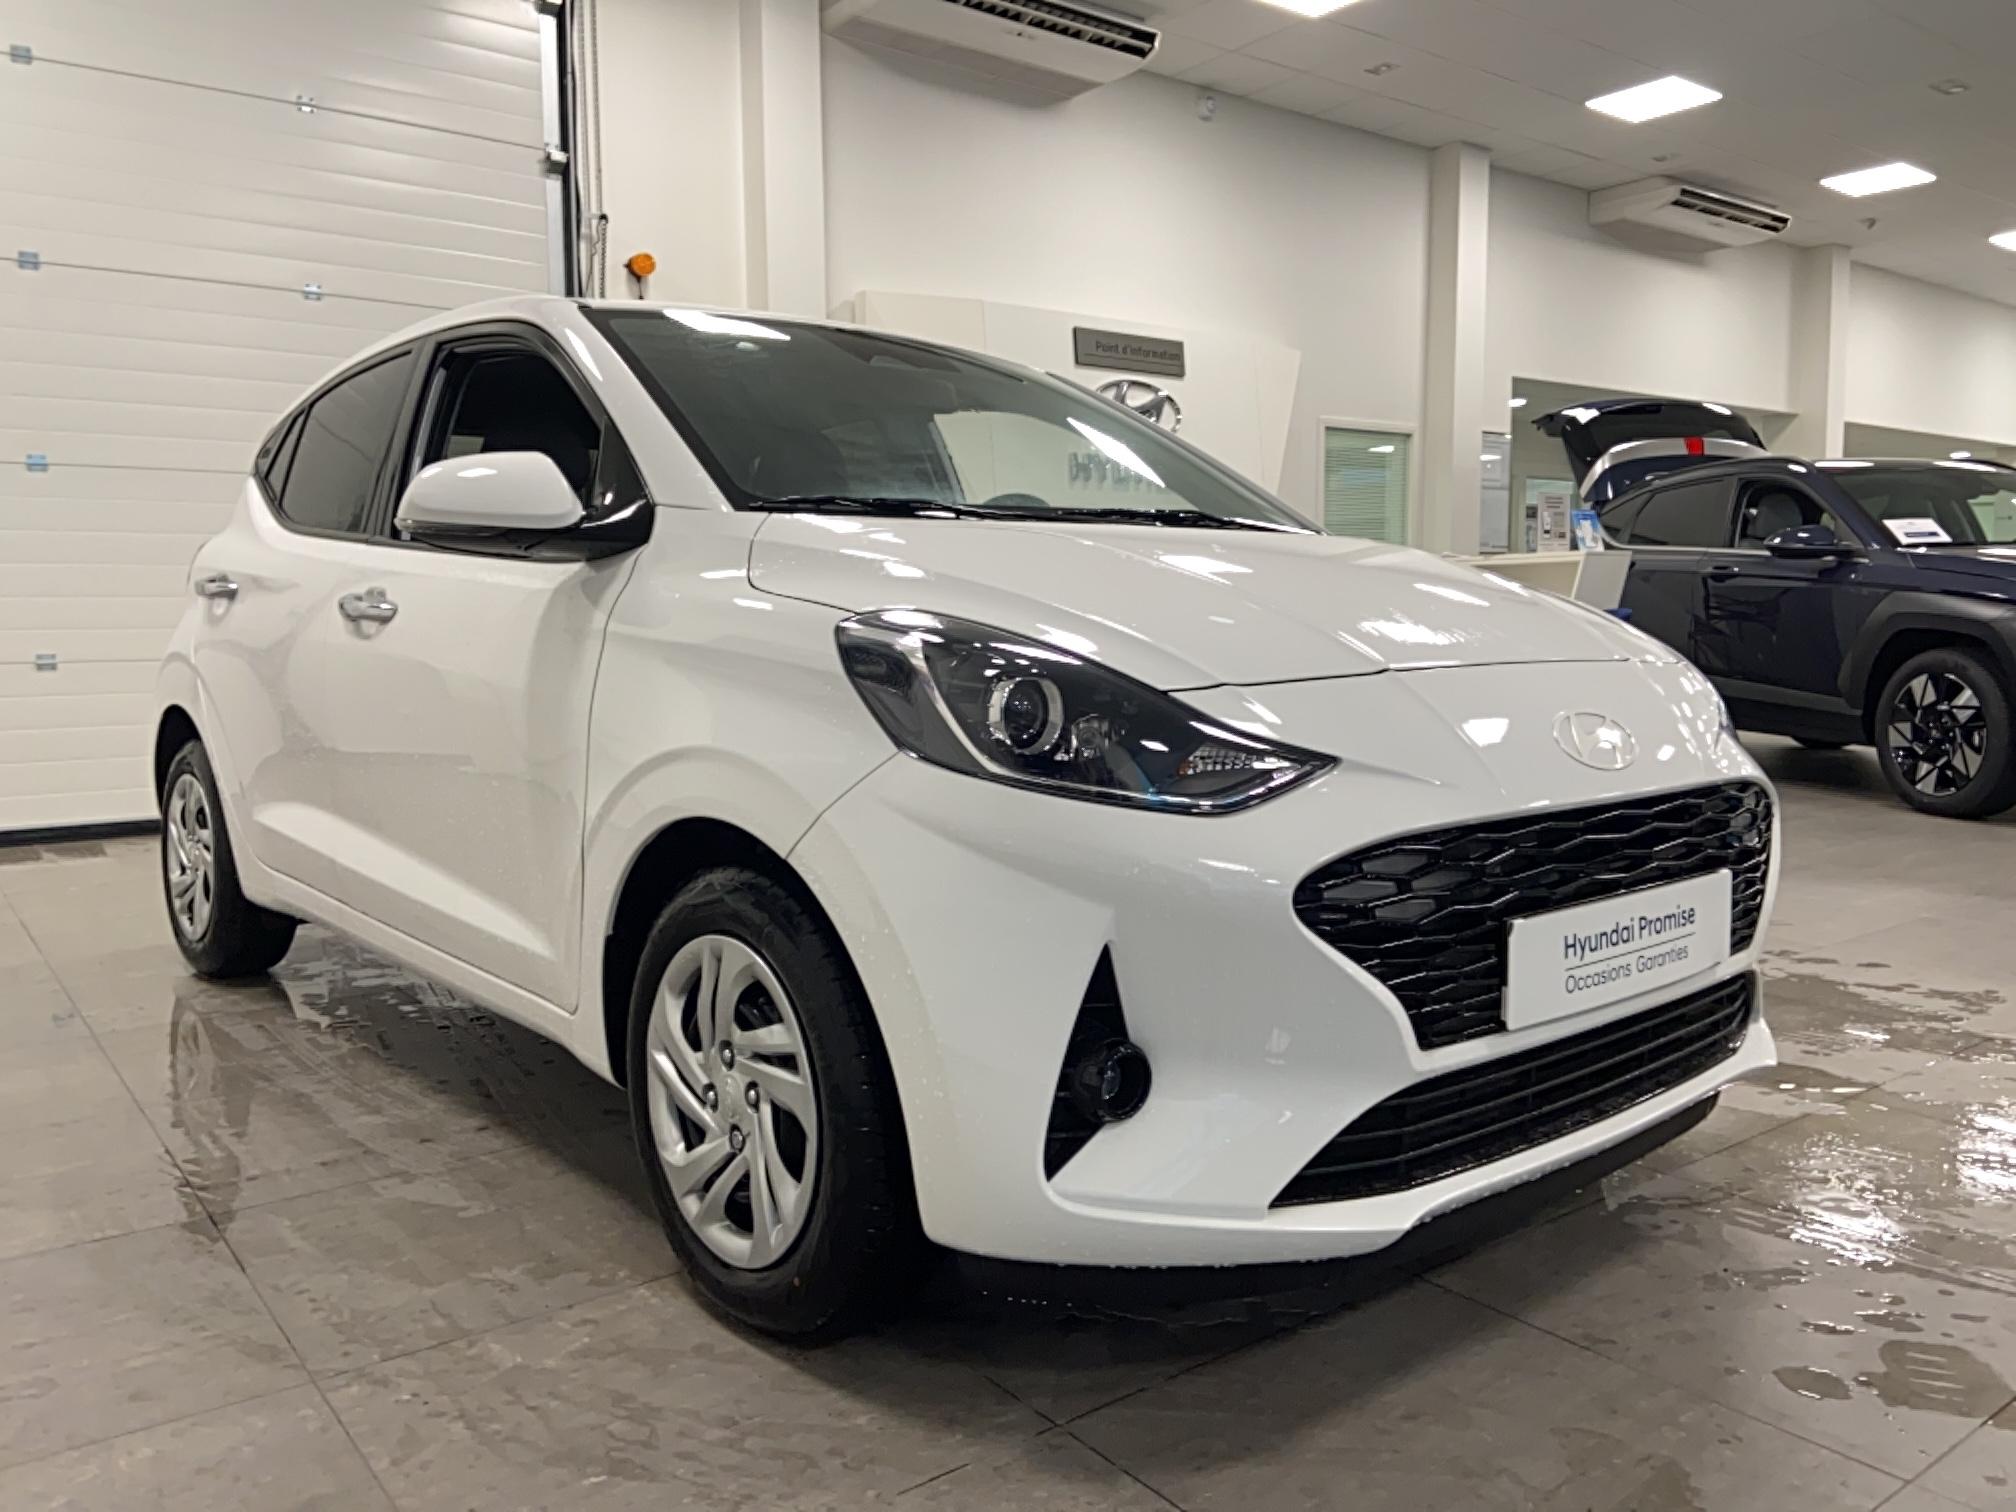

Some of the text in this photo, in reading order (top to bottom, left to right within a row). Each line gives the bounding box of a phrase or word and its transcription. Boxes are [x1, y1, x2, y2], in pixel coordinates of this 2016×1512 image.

[1095, 340, 1119, 354] Point
[1564, 905, 1696, 961] Hyundai Promise
[1565, 944, 1689, 994] Occasions Garanties
